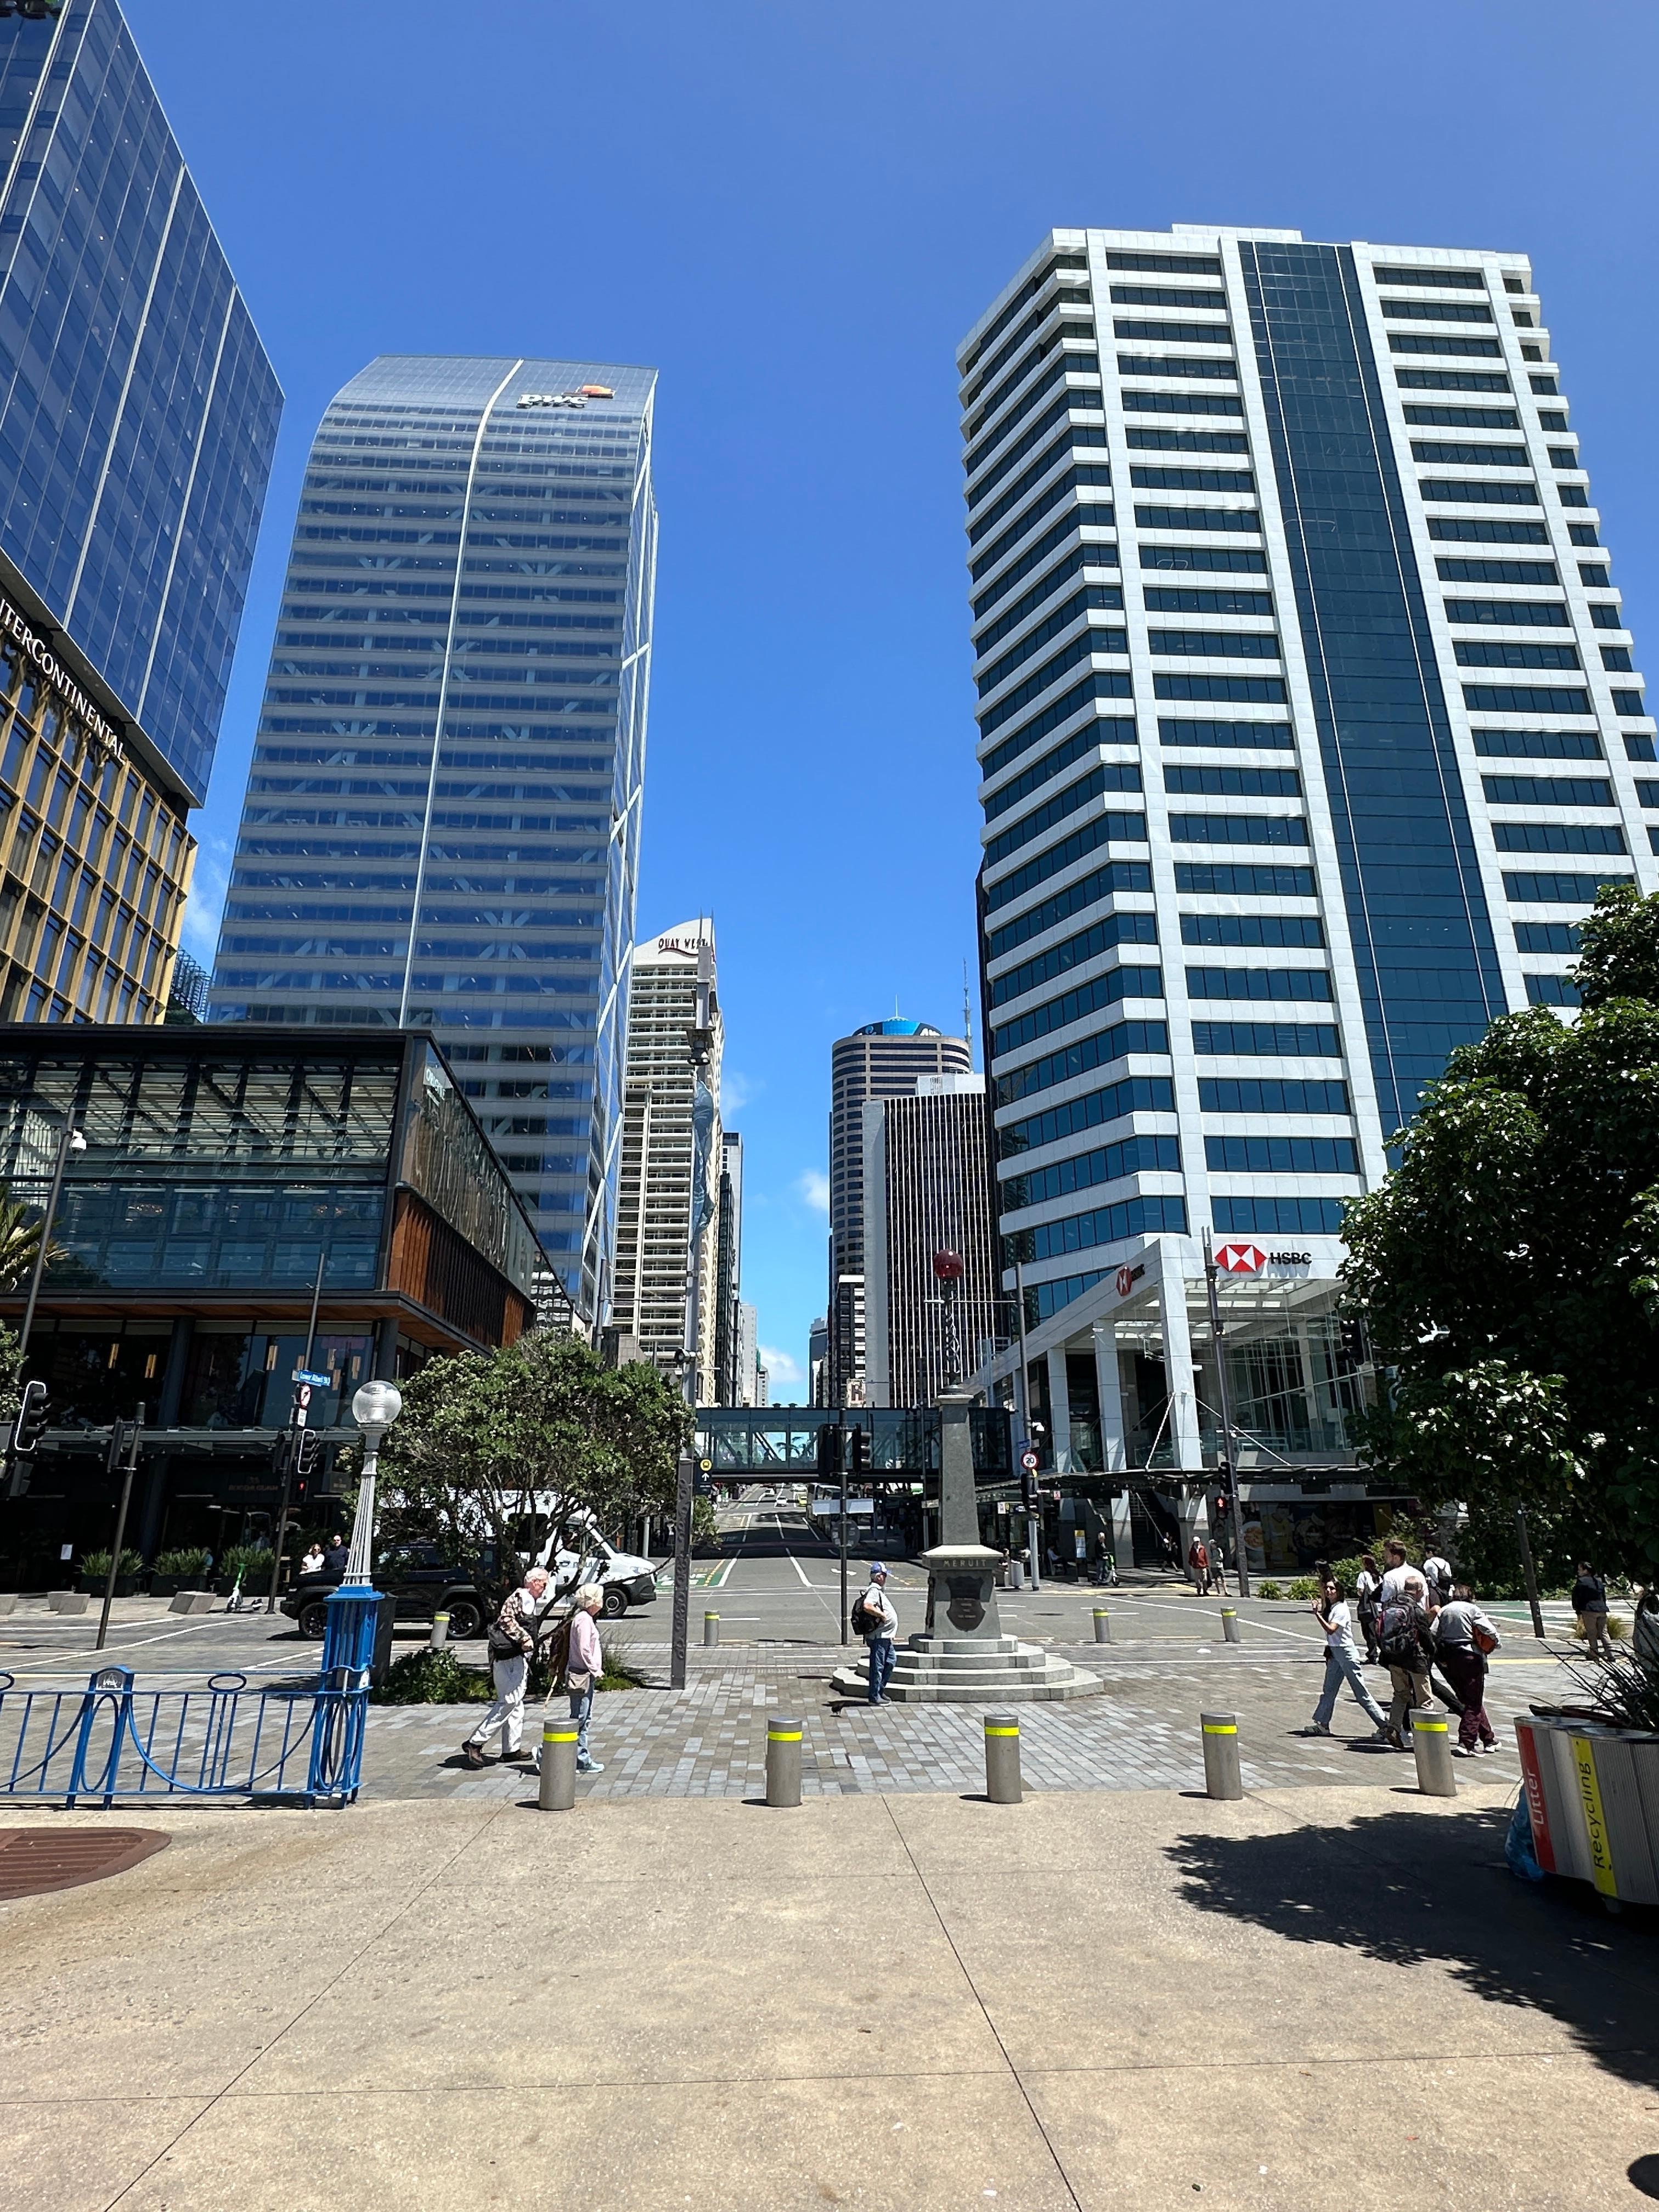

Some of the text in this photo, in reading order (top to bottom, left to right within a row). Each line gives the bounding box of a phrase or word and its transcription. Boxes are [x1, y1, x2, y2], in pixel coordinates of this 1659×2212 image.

[658, 938, 680, 949] QUAY
[1270, 1252, 1312, 1265] HSBC
[1527, 1769, 1545, 1825] Litter
[1578, 1762, 1606, 1870] Recycling
